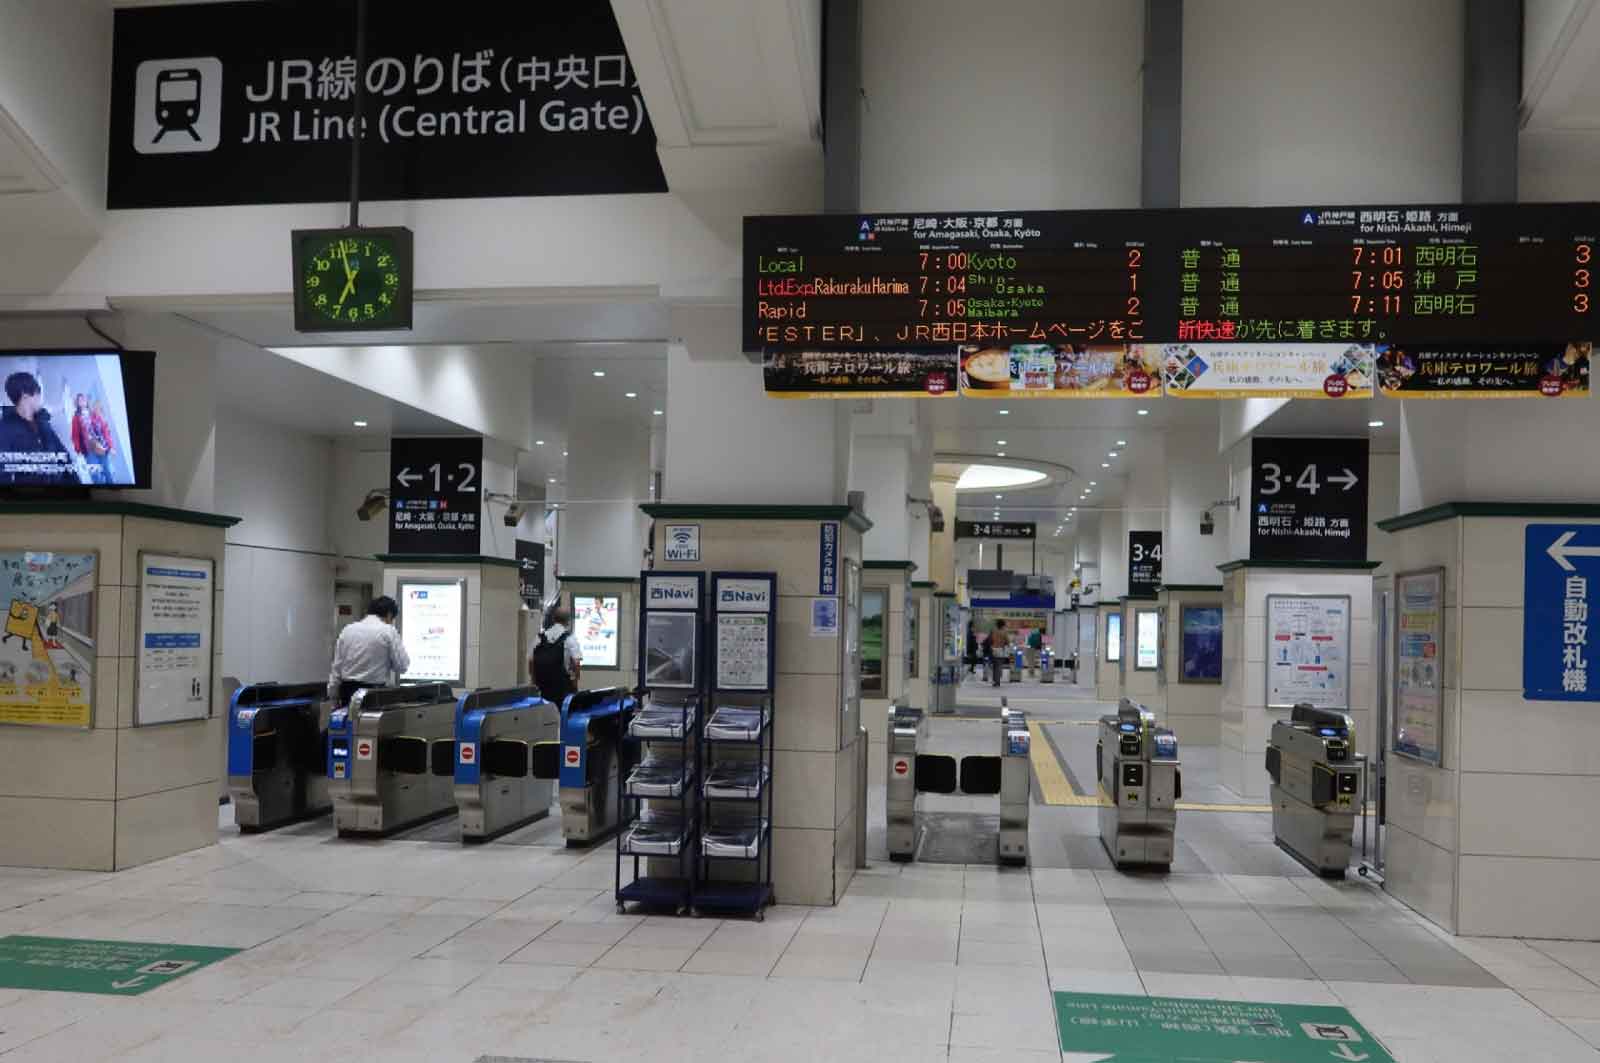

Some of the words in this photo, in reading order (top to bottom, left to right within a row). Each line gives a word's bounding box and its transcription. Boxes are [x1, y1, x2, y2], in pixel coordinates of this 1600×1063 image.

[242, 111, 281, 143] JR
[379, 99, 526, 143] (Central
[539, 94, 644, 135] Gate)
[1303, 213, 1313, 223] A
[860, 220, 870, 230] A
[1360, 223, 1375, 232] for
[1376, 223, 1438, 234] Nishi-Akashi,
[1440, 222, 1472, 234] Himeji
[913, 230, 927, 239] for
[928, 230, 981, 241] Amagasaki,
[345, 239, 358, 254] 12
[330, 247, 341, 259] 11
[1352, 247, 1402, 266] 7:01
[1415, 246, 1479, 266] 西明石
[1575, 244, 1591, 264] 3
[317, 260, 330, 272] 10
[377, 255, 389, 268] 2
[759, 255, 803, 273] Local
[919, 252, 967, 270] 7:00
[968, 252, 1017, 271] Kyoto
[1127, 249, 1141, 268] 2
[310, 276, 320, 288] 9
[385, 273, 395, 285] 3
[919, 275, 967, 294] 7:04
[1129, 273, 1139, 292] 1
[1351, 271, 1403, 289] 7:05
[1574, 269, 1590, 288] 3
[996, 283, 1046, 294] Osaka
[318, 294, 327, 305] 8
[379, 292, 388, 303] 4
[332, 304, 341, 316] 7
[364, 303, 373, 315] 5
[758, 300, 807, 320] Rapid
[919, 299, 966, 318] 7:05
[1127, 297, 1140, 316] 2
[1351, 295, 1401, 314] 7:11
[1414, 294, 1479, 315] 西明石
[1573, 294, 1589, 313] 3
[348, 307, 358, 319] 6
[967, 307, 1019, 318] Maibara
[1258, 527, 1270, 536] for
[1324, 527, 1351, 538] Himeji
[1562, 575, 1588, 692] 自動改札機
